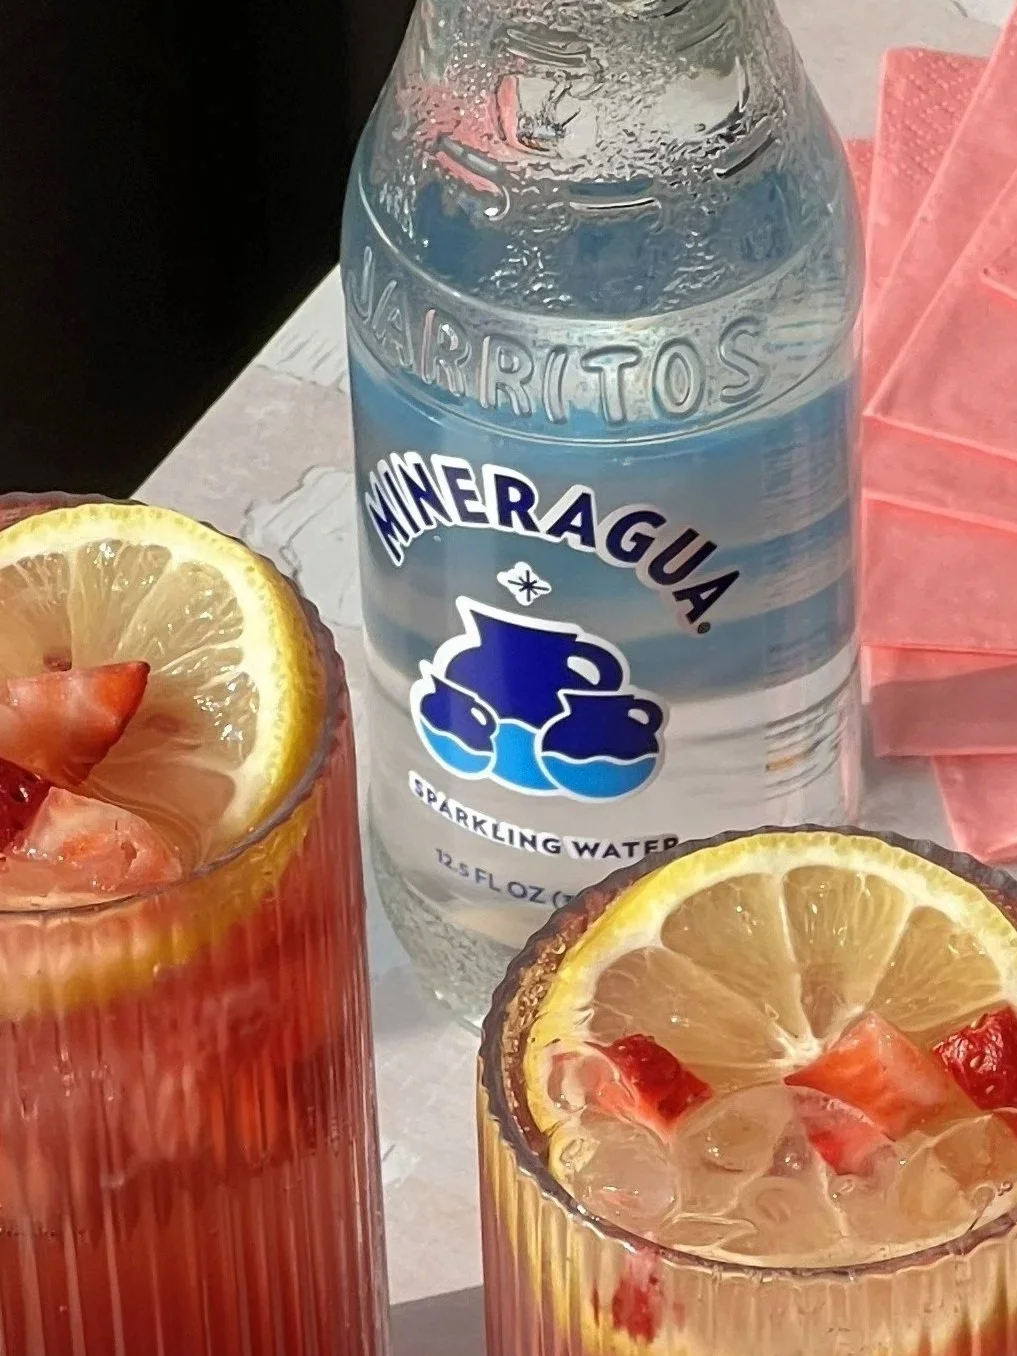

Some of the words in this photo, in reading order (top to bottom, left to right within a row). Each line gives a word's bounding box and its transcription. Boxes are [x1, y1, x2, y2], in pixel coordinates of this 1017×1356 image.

[347, 246, 769, 425] JARRITOS
[368, 457, 740, 626] MINERAGUA
[412, 777, 561, 855] SPARKLING
[435, 848, 470, 878] 12.5
[475, 870, 498, 892] FL
[508, 881, 546, 905] OZ
